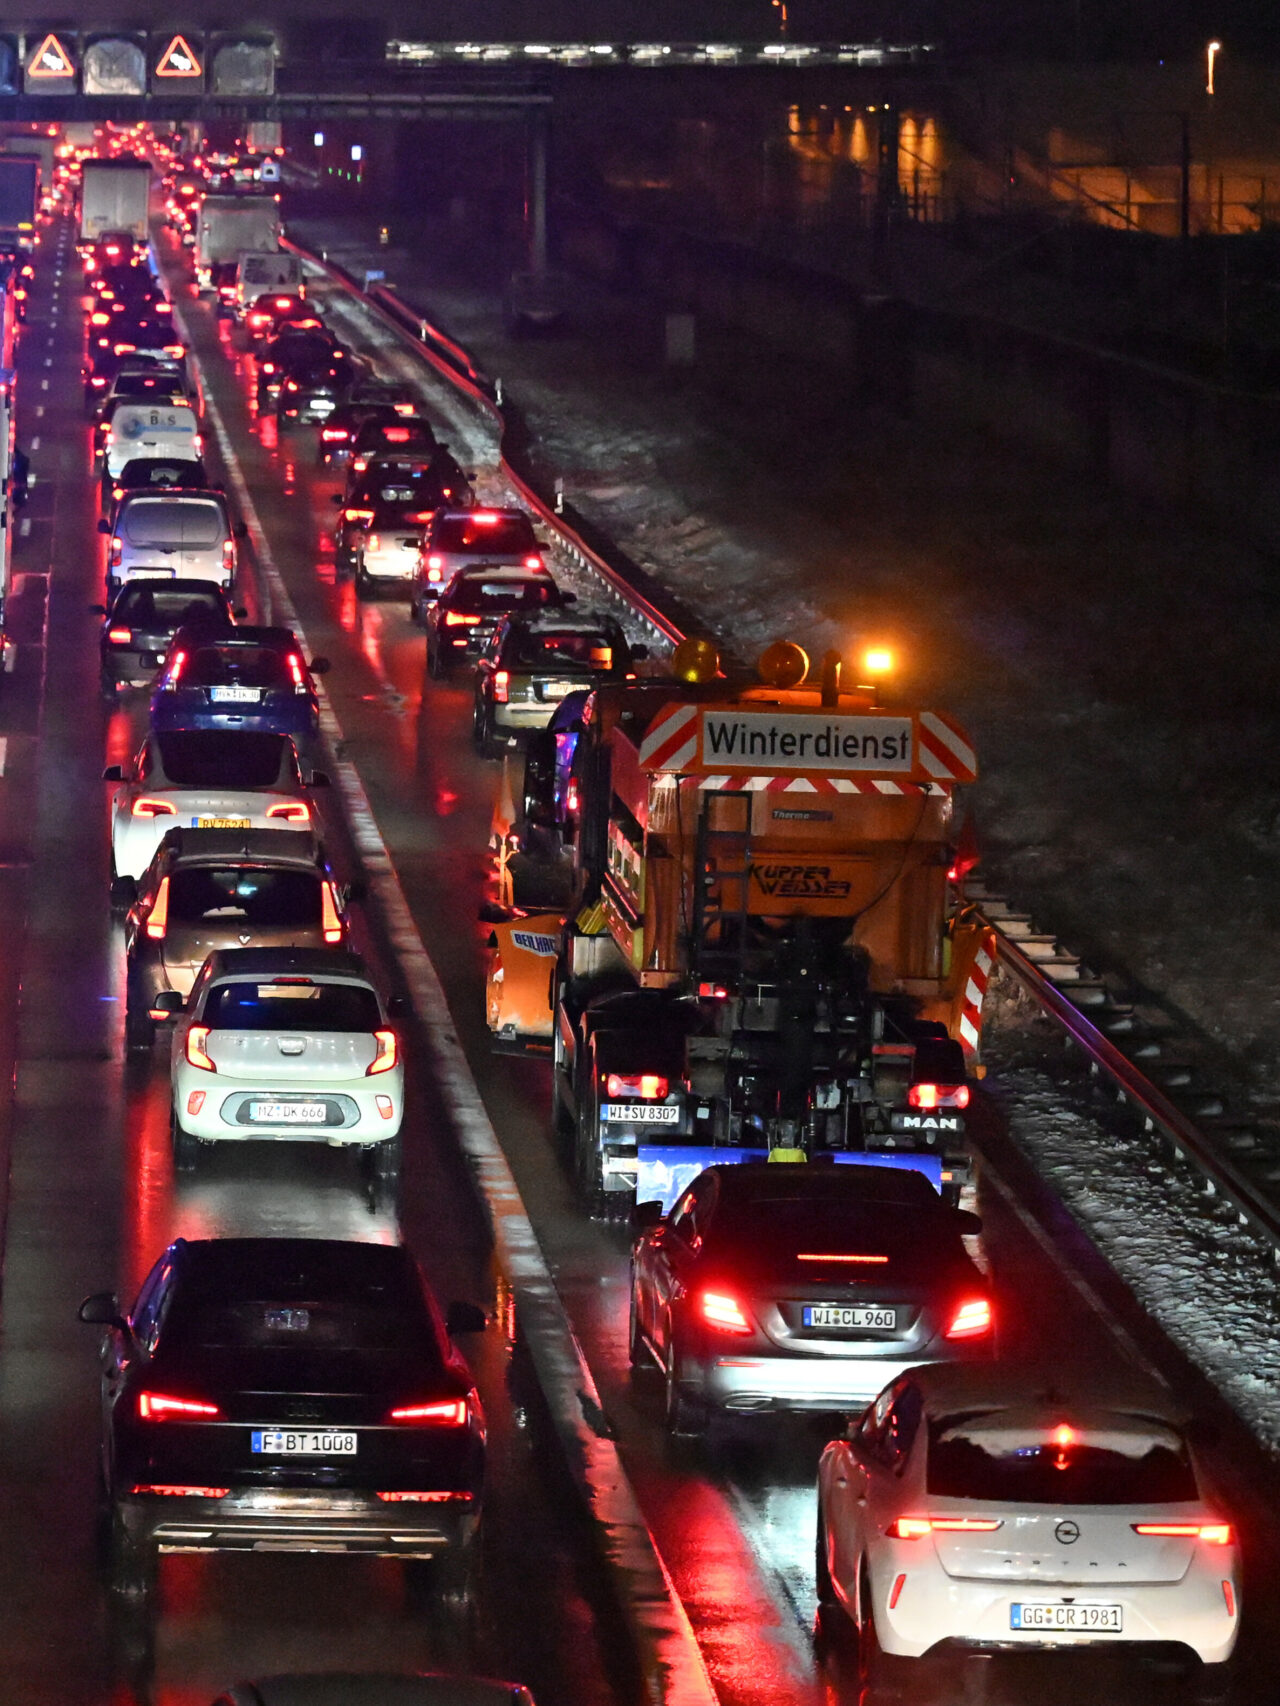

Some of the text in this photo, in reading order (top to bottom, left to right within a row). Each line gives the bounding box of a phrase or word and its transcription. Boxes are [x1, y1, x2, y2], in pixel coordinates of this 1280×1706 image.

[707, 721, 910, 760] Winterdienst
[258, 1106, 274, 1117] MZ
[301, 1107, 324, 1118] 666
[610, 1107, 677, 1120] WI SV 8302
[903, 1117, 957, 1129] MAN
[813, 1310, 893, 1326] WI CL 960
[263, 1434, 354, 1451] F BT 1008
[1023, 1608, 1119, 1626] GG CR 1981
